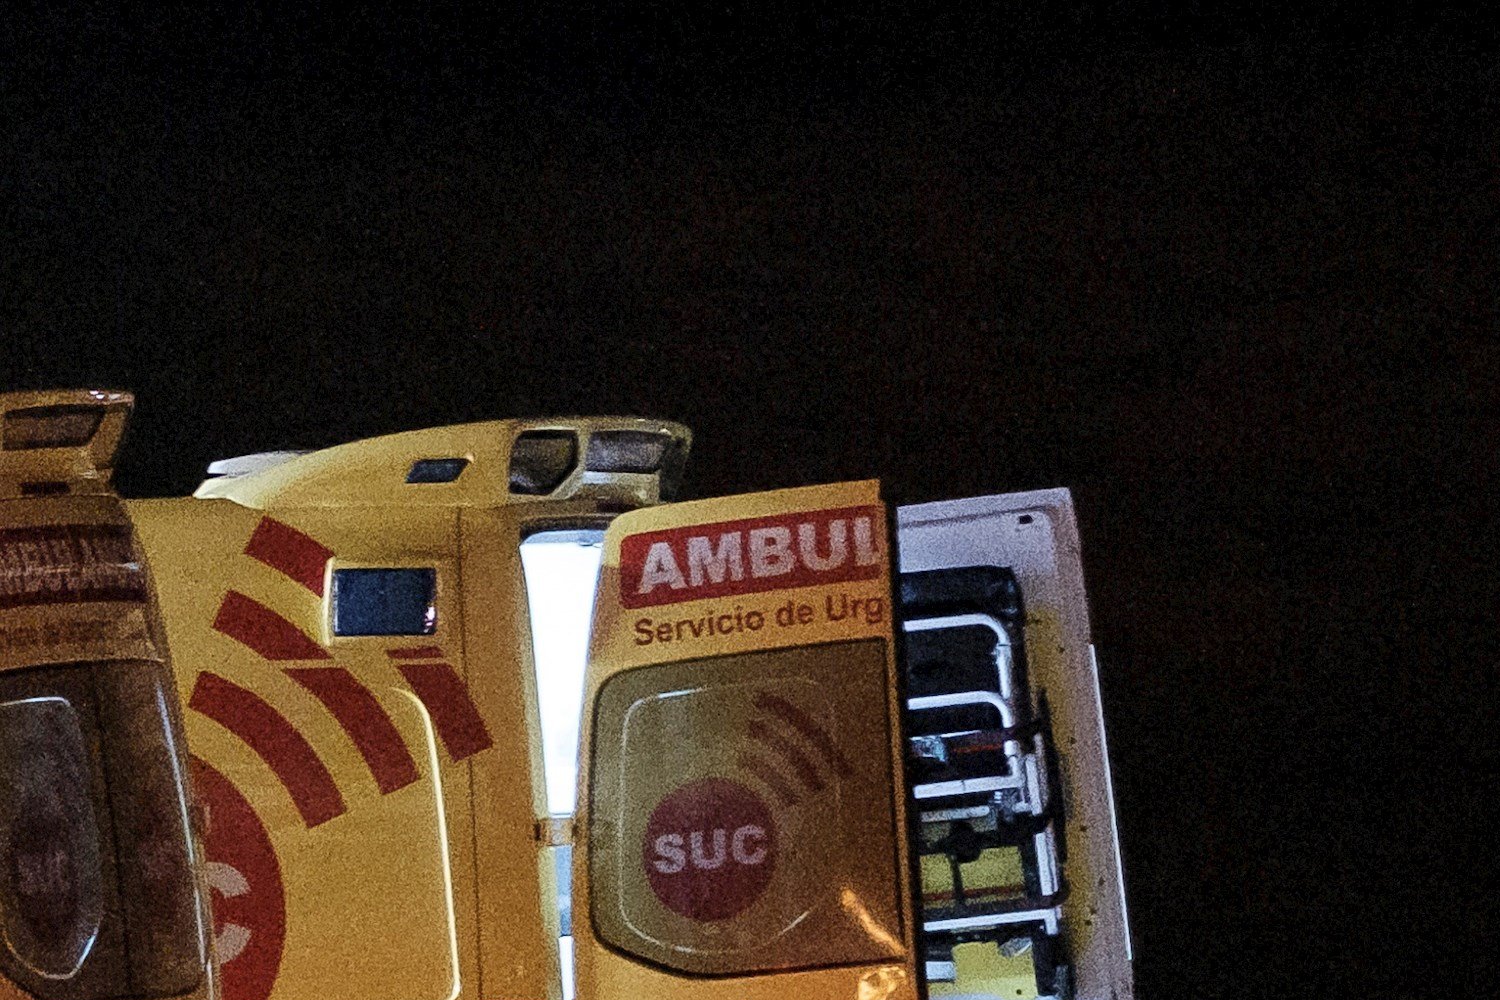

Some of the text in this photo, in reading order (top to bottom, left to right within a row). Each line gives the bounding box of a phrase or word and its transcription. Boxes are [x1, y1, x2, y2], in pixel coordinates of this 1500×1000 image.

[635, 605, 765, 646] Servicio
[776, 601, 813, 628] de
[653, 824, 768, 874] SUC
